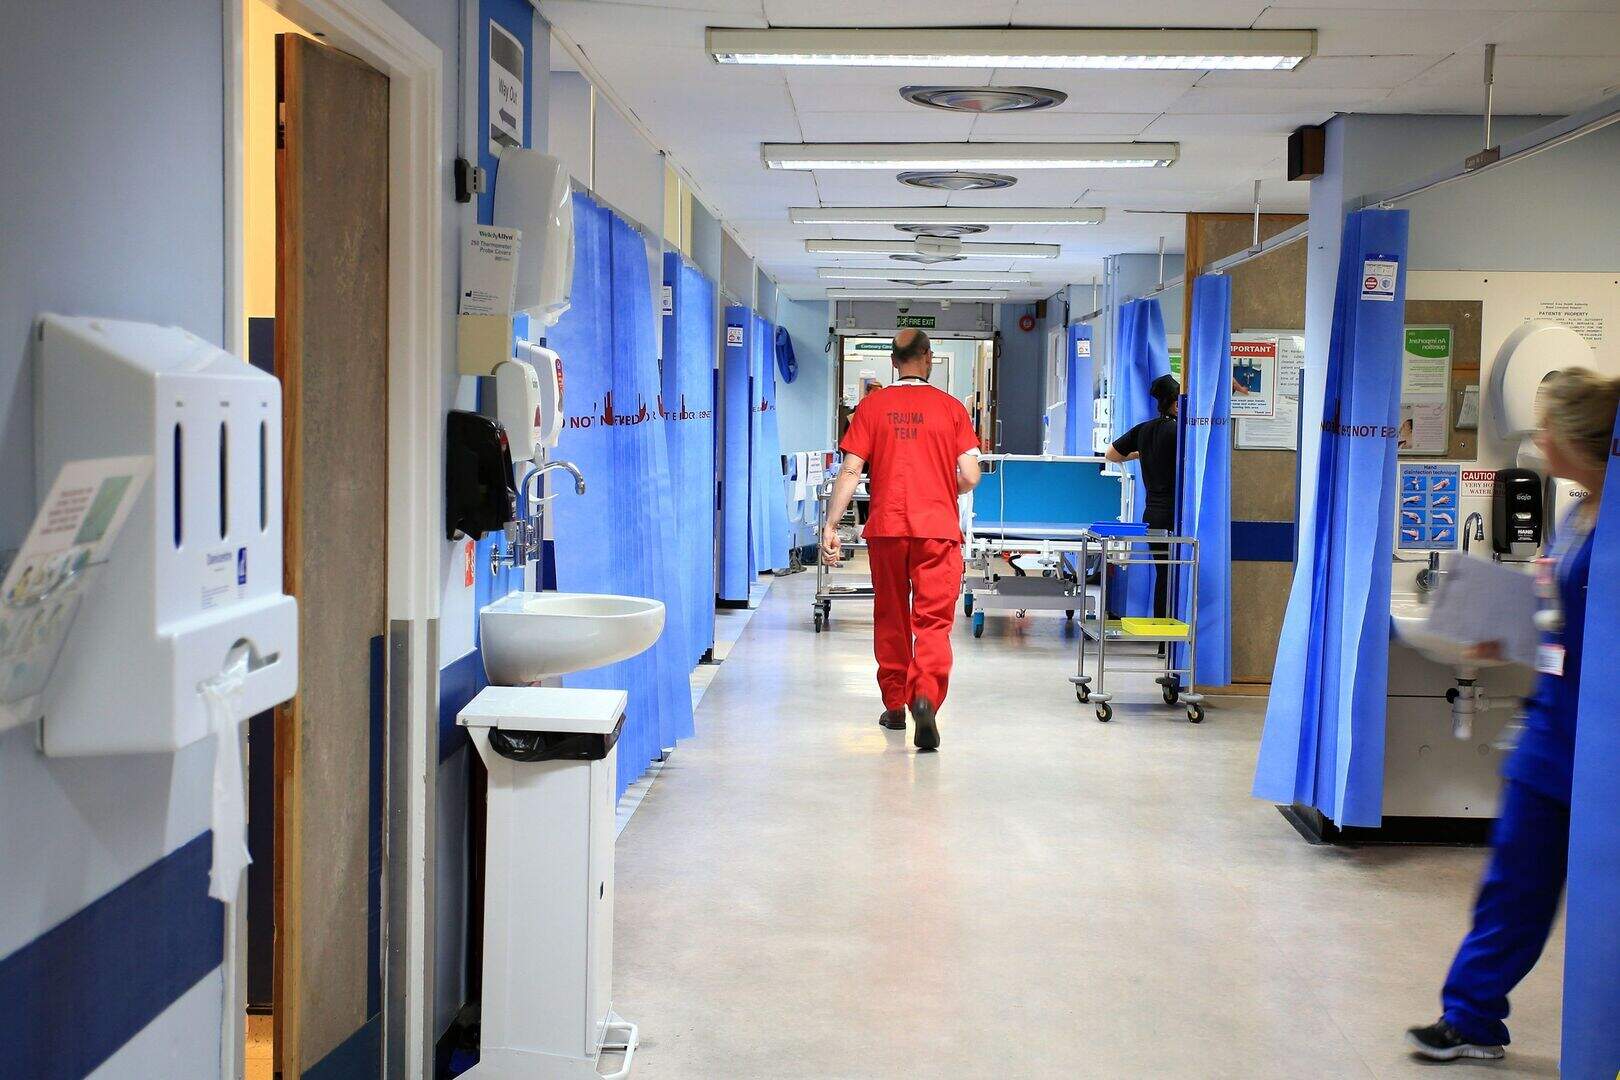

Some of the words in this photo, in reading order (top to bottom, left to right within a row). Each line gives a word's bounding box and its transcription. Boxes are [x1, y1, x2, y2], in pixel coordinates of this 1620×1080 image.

[498, 78, 510, 102] Way
[510, 86, 519, 105] Out
[480, 240, 512, 250] Thermometer
[480, 247, 494, 255] Probe
[908, 318, 921, 326] FIRE
[922, 318, 935, 326] EXIT
[887, 412, 924, 425] TRAUMA
[895, 427, 917, 440] TEAM
[1352, 426, 1378, 437] NOT
